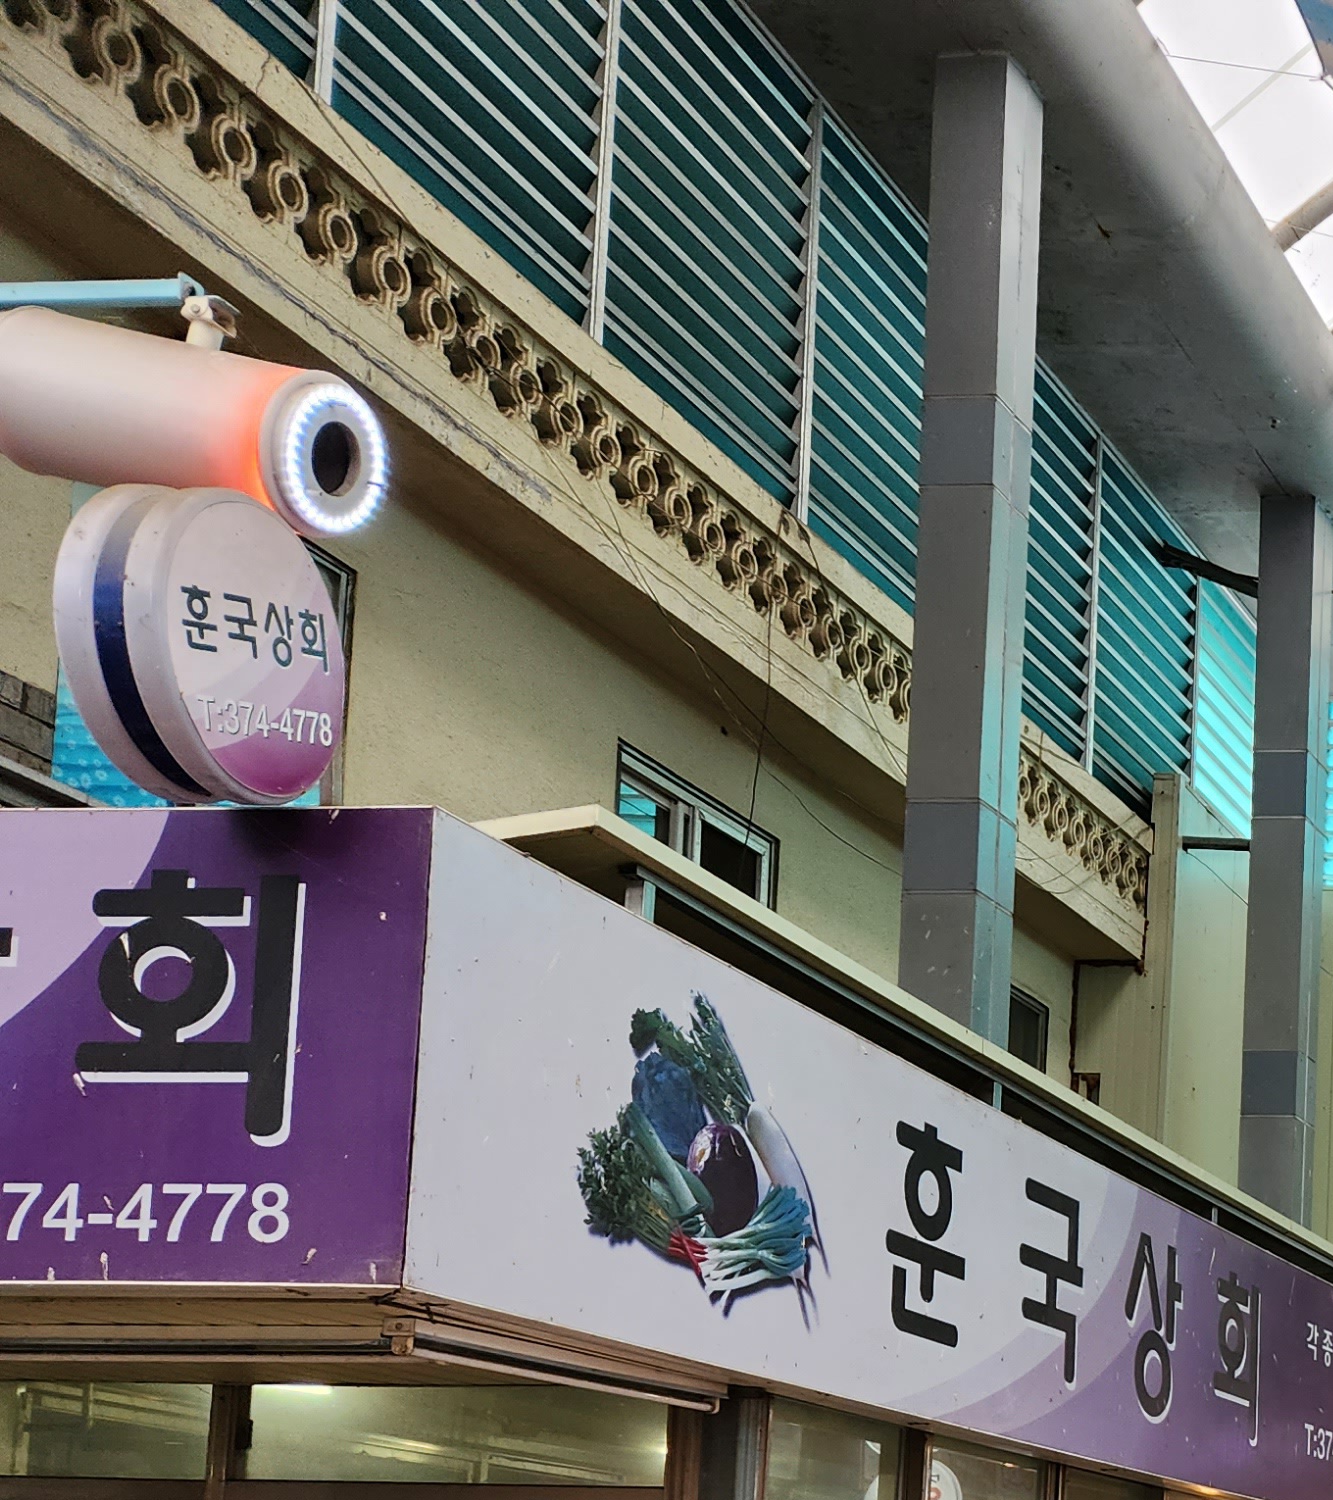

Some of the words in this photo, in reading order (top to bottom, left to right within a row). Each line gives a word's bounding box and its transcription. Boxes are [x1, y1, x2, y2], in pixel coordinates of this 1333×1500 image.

[180, 584, 331, 673] 훈국상회
[196, 694, 334, 748] T:374-4778
[885, 1119, 1263, 1447] 훈국상회
